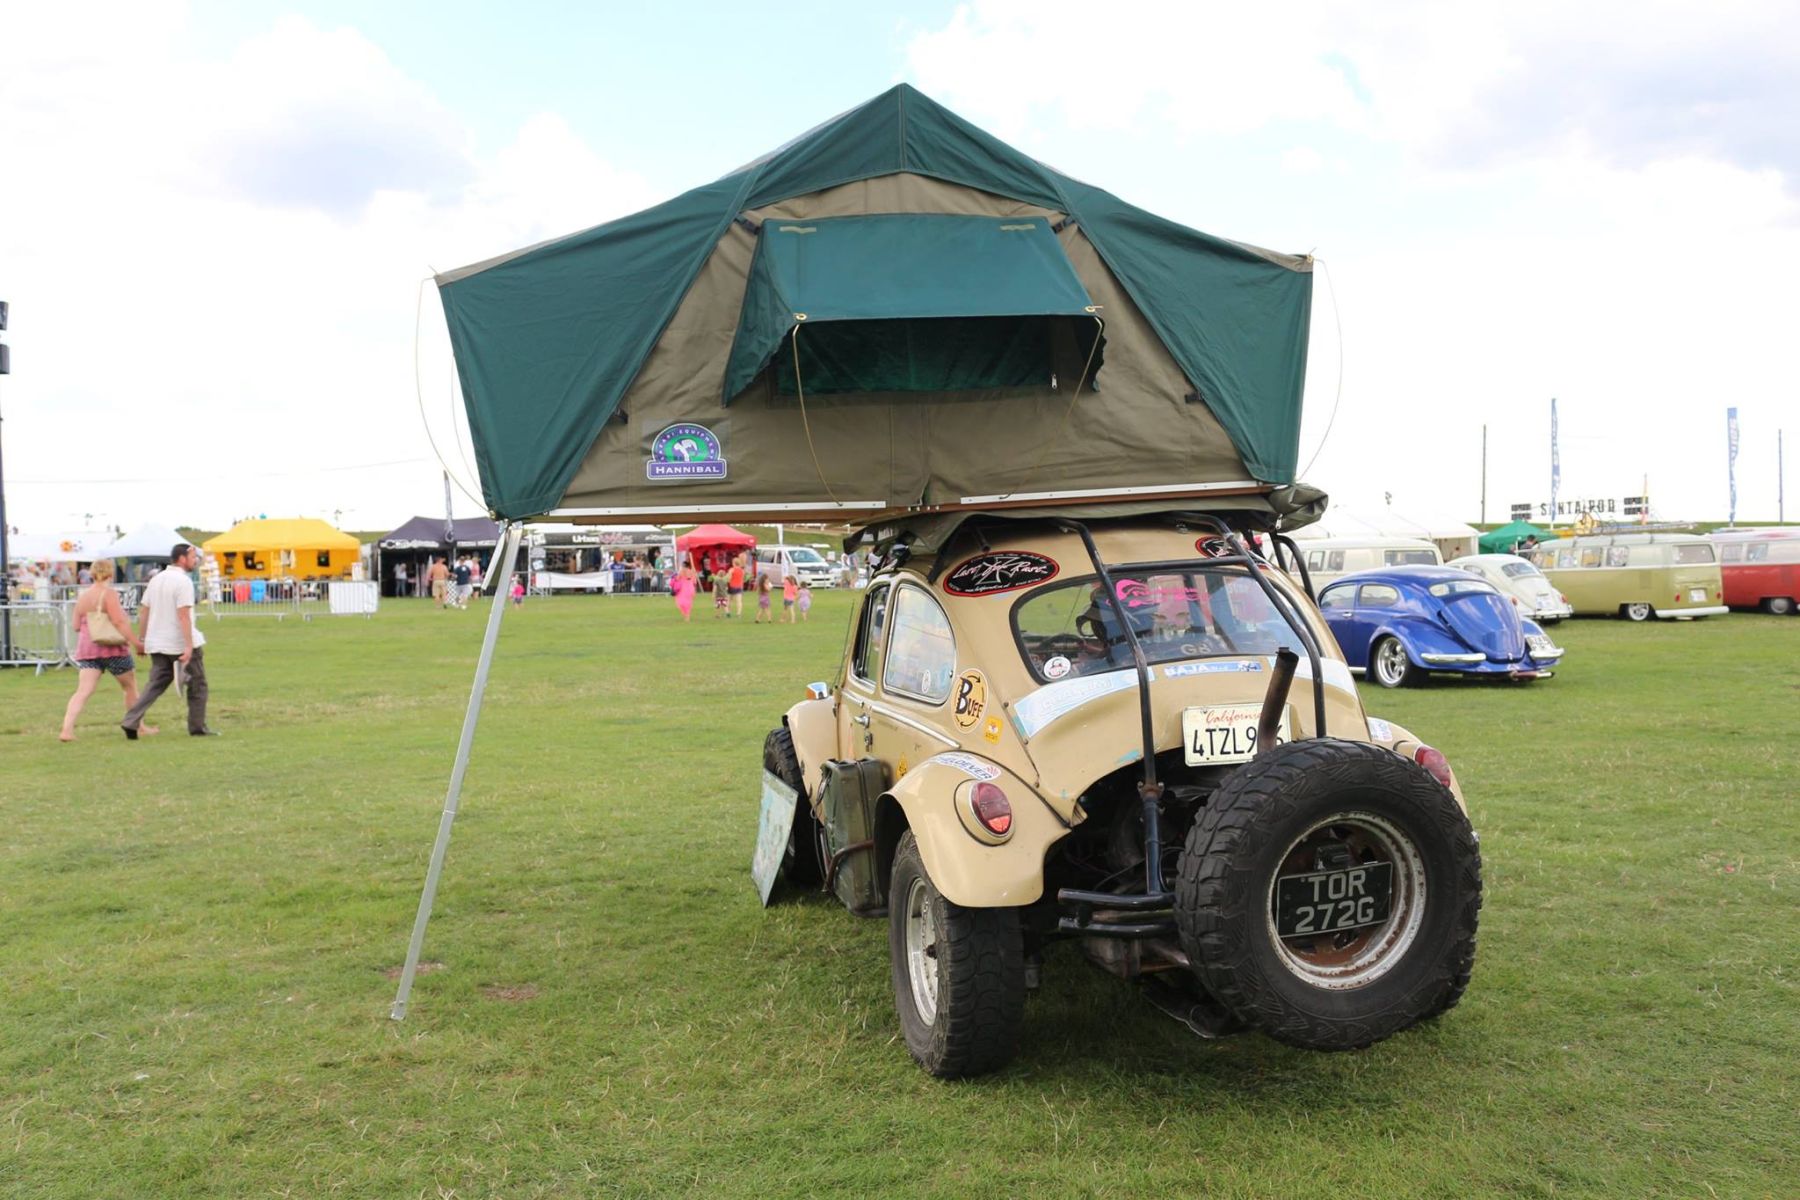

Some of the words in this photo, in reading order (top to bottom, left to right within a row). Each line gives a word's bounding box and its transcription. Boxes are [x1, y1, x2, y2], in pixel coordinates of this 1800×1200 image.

[655, 466, 720, 474] HANNIBAL
[1540, 501, 1583, 516] SNTA
[955, 676, 983, 719] BUFF
[1205, 709, 1264, 726] Californi
[1308, 869, 1366, 902] TOR
[1295, 896, 1374, 933] 272G
